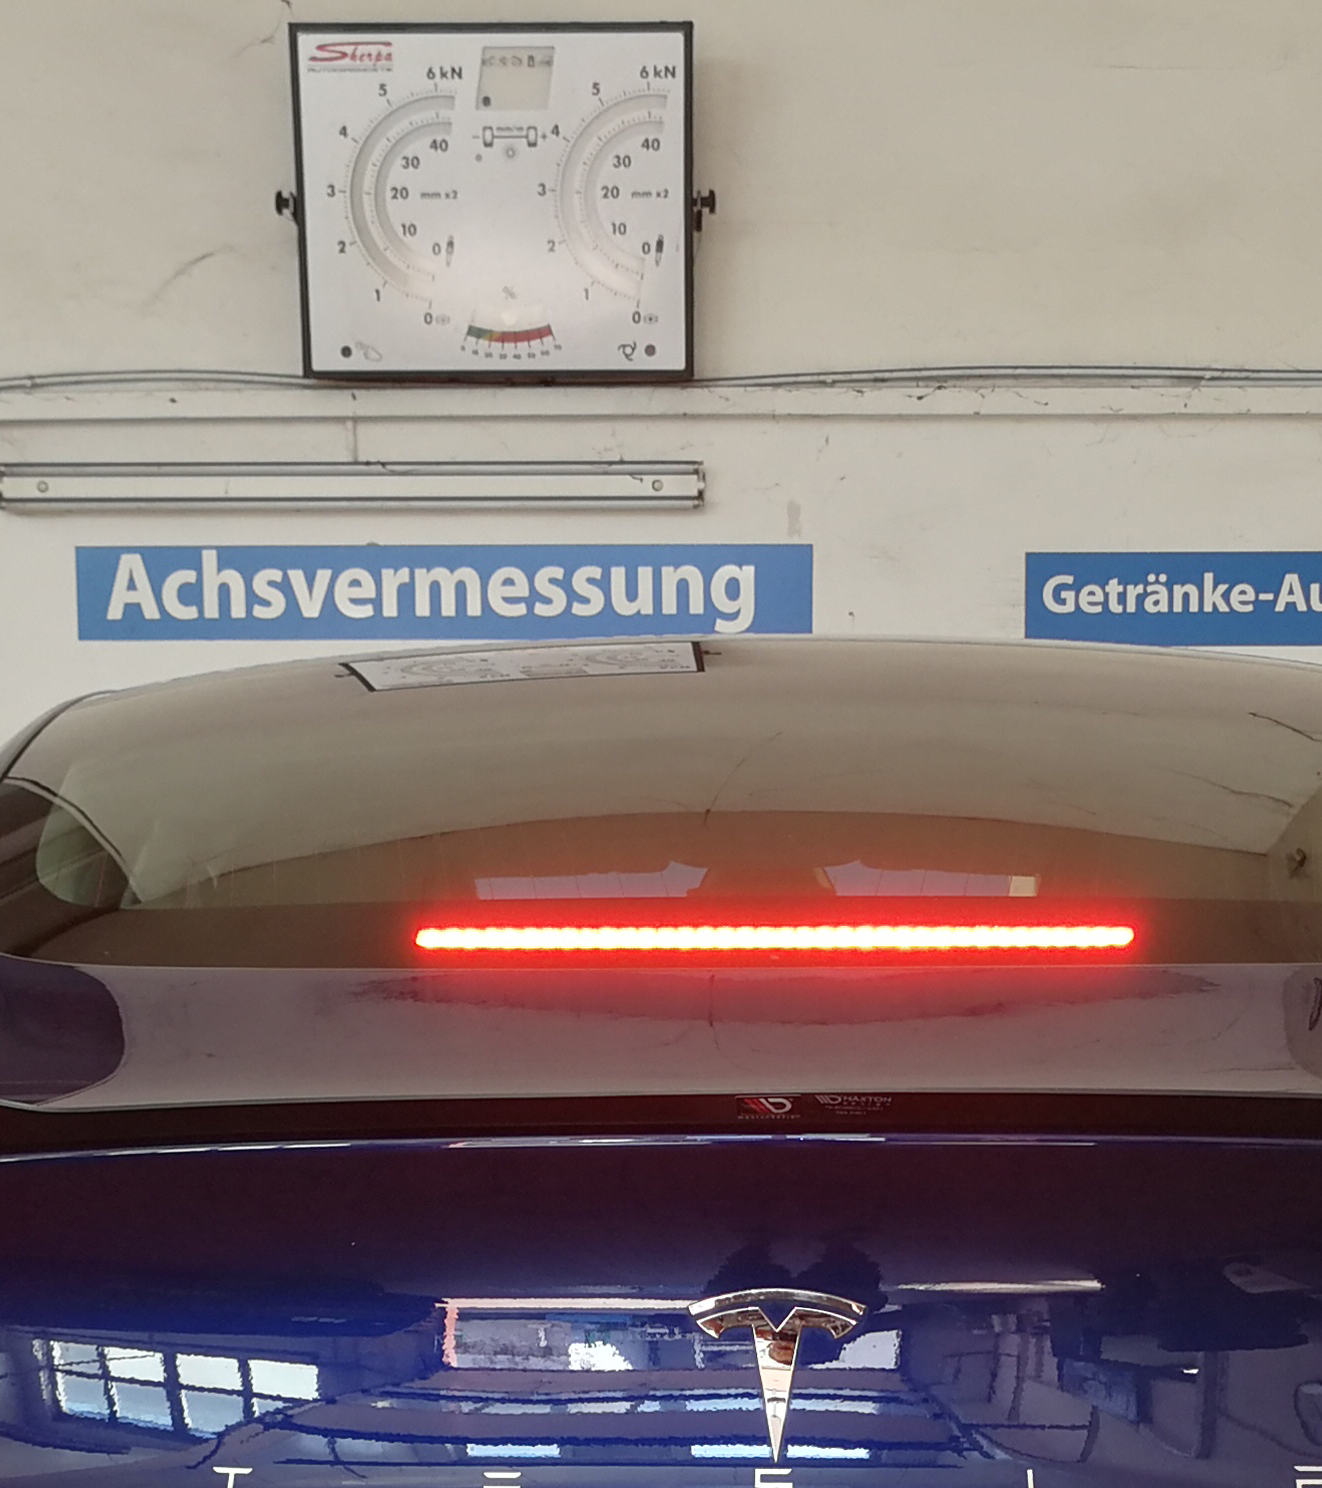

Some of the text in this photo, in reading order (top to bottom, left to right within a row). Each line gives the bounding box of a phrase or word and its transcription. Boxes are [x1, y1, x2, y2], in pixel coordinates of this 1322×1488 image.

[427, 66, 463, 80] 6 kN
[639, 65, 676, 79] 6 kN
[378, 83, 388, 97] 5
[591, 82, 601, 96] 5
[339, 125, 348, 138] 4
[551, 124, 560, 137] 4
[429, 139, 449, 152] 40
[641, 138, 661, 151] 40
[401, 156, 420, 169] 30
[612, 155, 631, 168] 30
[327, 184, 336, 198] 3
[390, 187, 409, 200] 20
[537, 183, 546, 196] 3
[601, 186, 620, 199] 20
[401, 223, 417, 236] 10
[611, 222, 627, 235] 10
[337, 241, 346, 254] 2
[432, 242, 441, 255] 0
[547, 240, 555, 252] 2
[642, 242, 651, 255] 0
[106, 549, 756, 633] Achsvermessung
